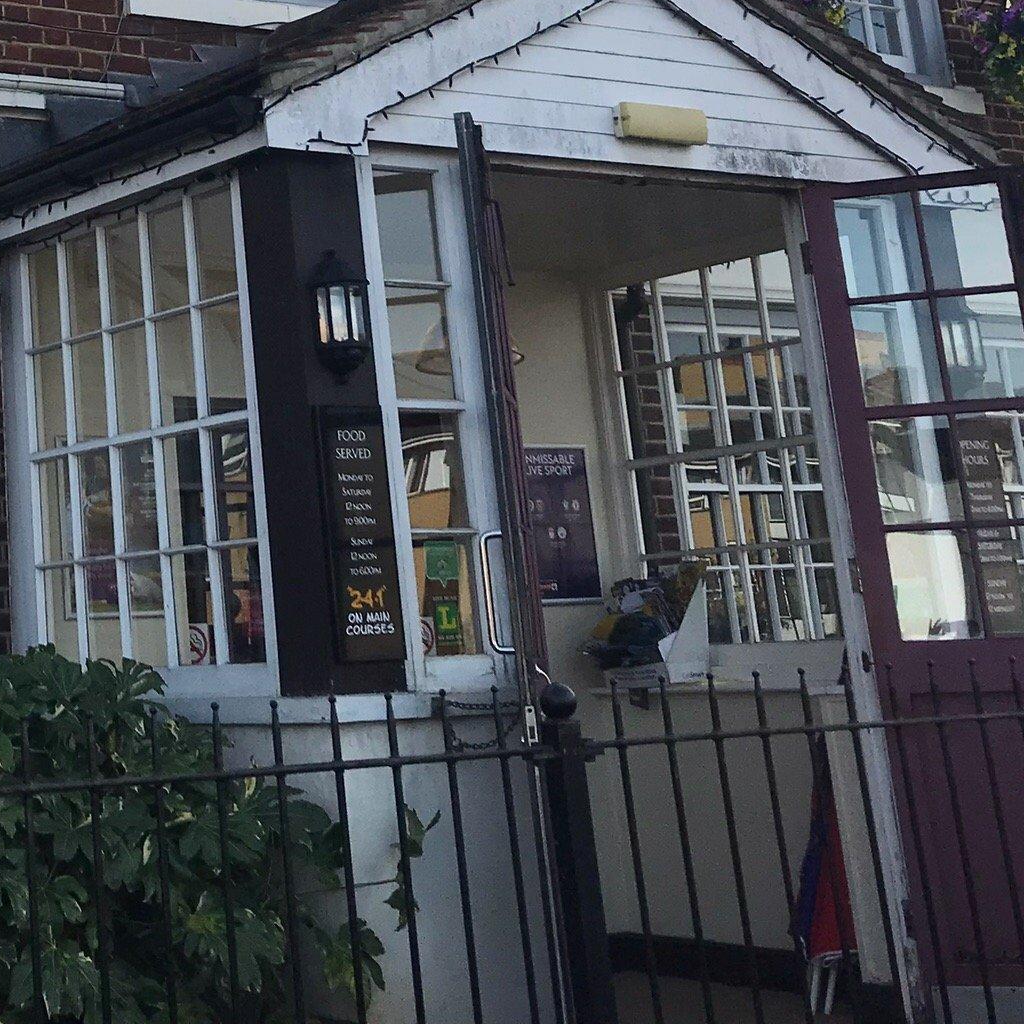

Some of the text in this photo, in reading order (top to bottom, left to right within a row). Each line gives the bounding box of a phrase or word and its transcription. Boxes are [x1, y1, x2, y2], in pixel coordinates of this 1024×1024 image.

[337, 429, 366, 441] FOOD
[960, 440, 990, 450] PENING
[335, 447, 371, 459] SERVED
[525, 454, 576, 465] NMISSABLE
[544, 465, 573, 476] SPORT
[348, 610, 390, 624] ON MAIN
[346, 623, 395, 636] COURSES
